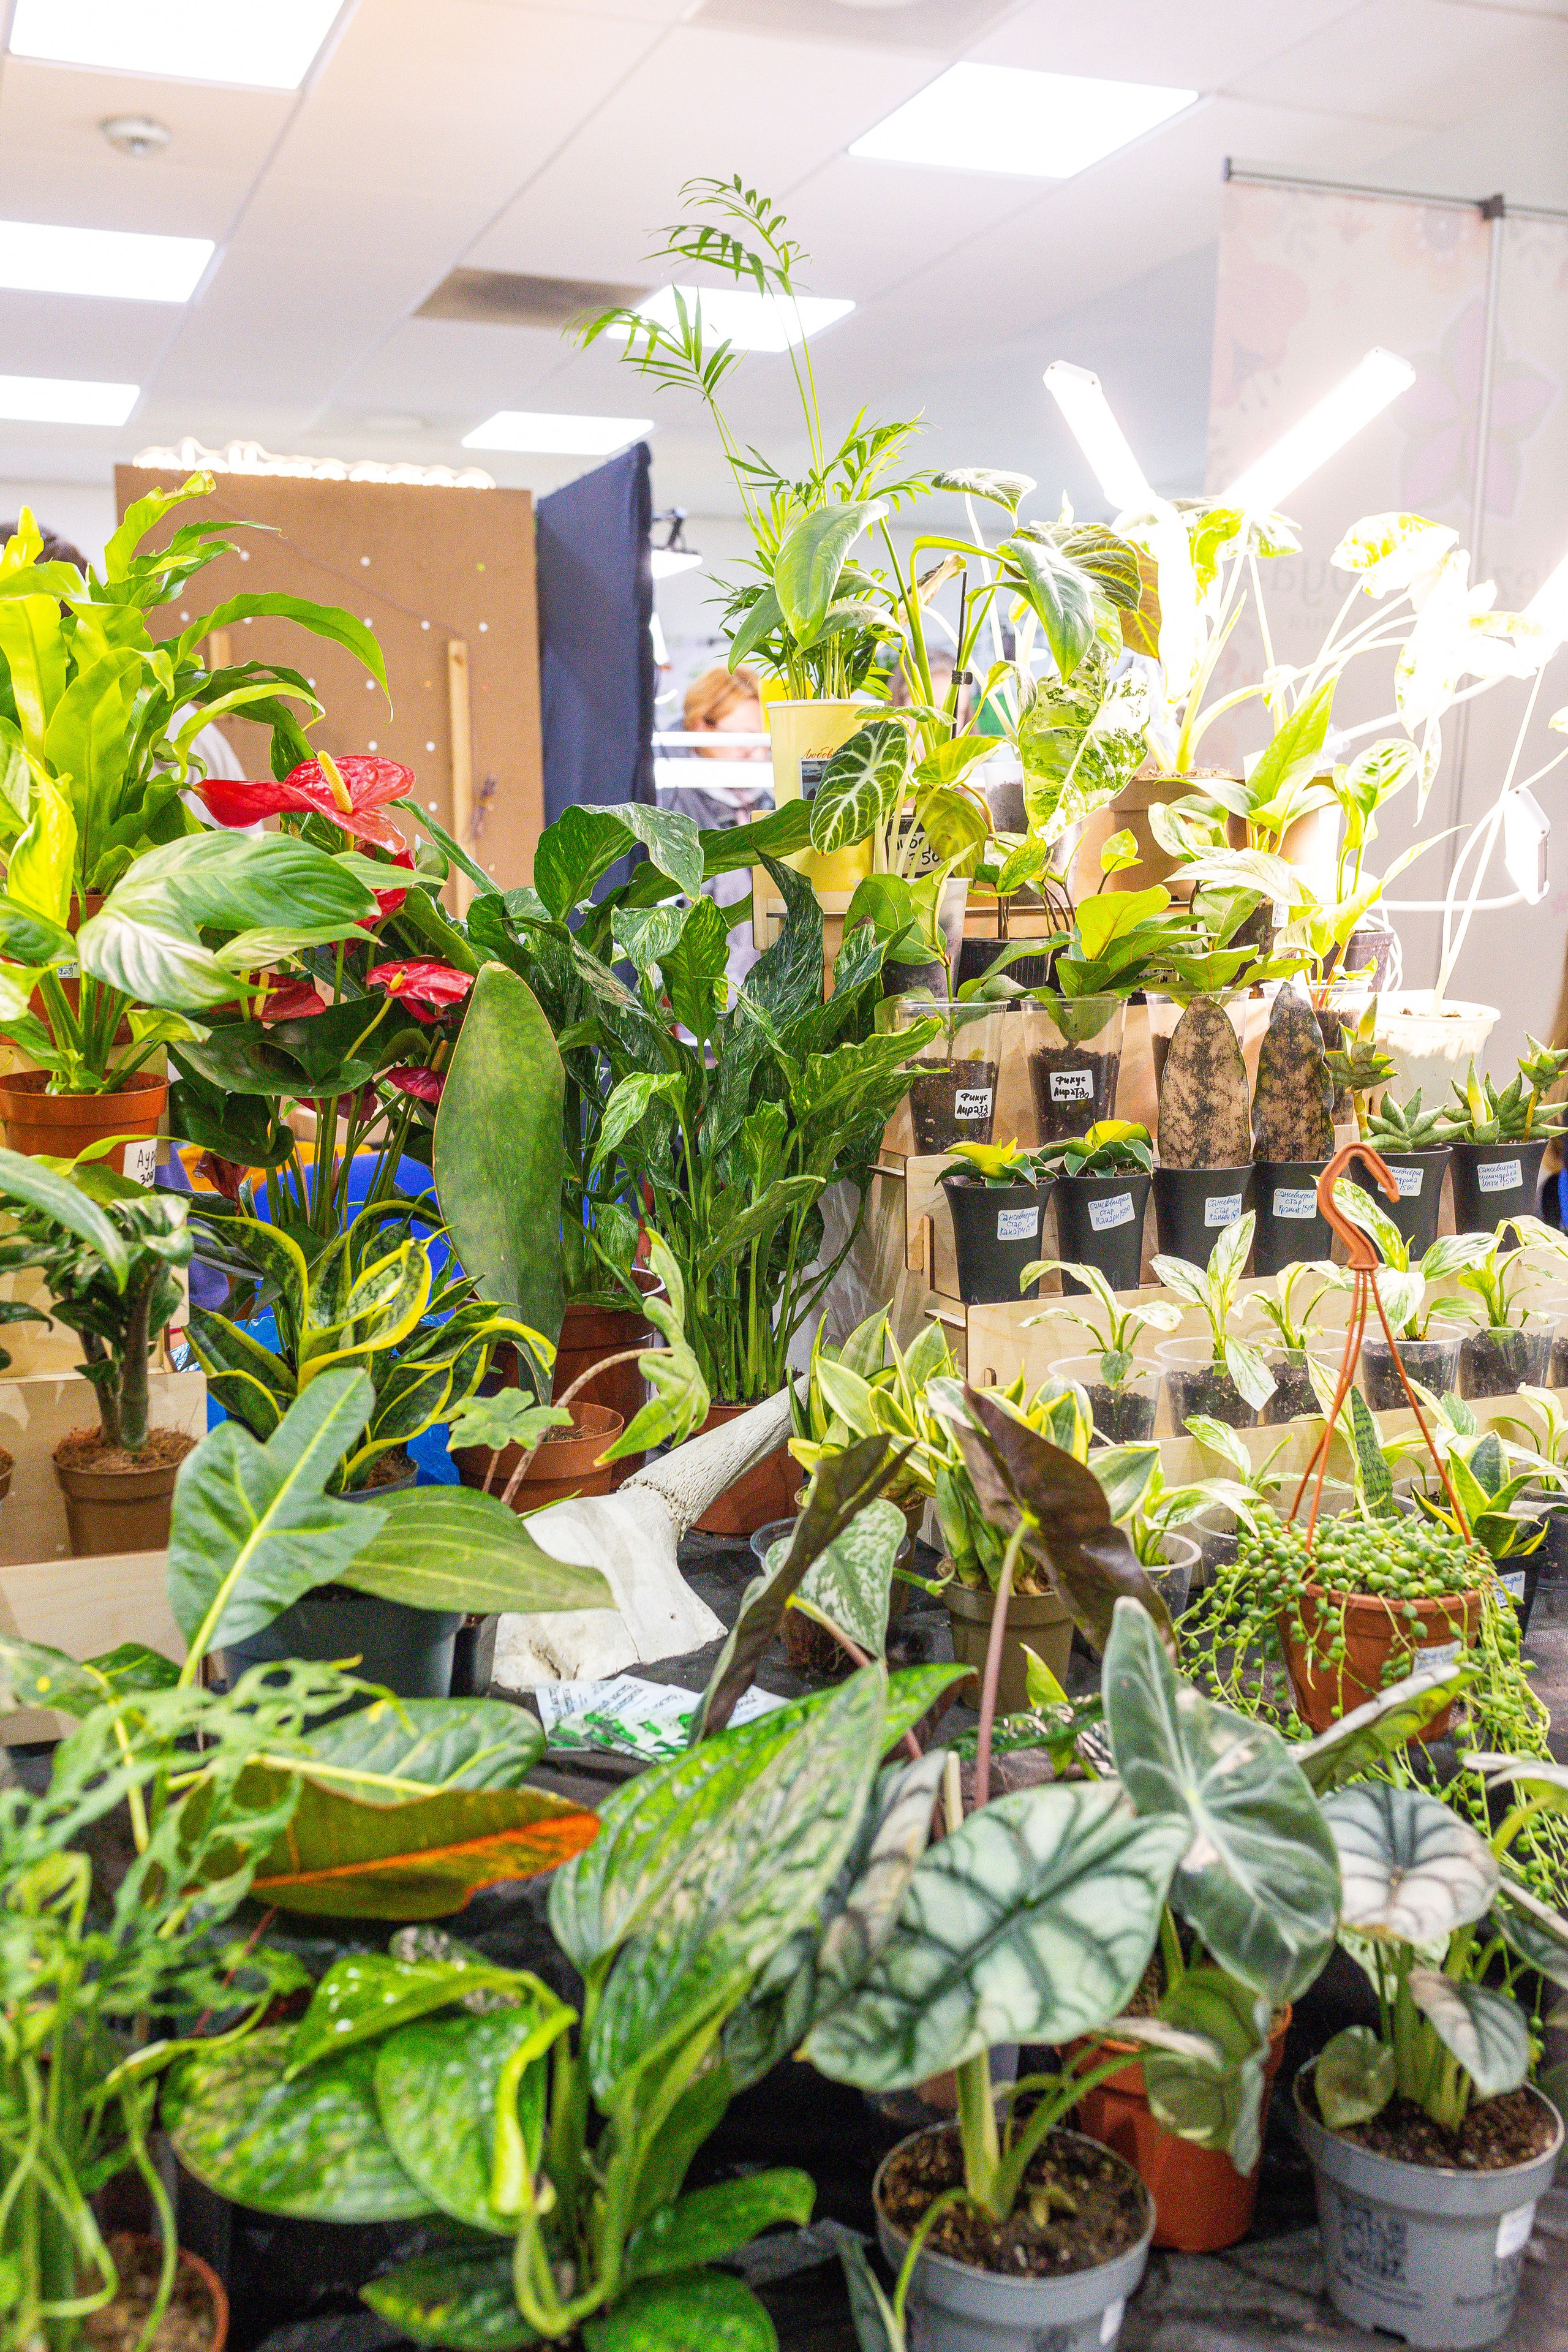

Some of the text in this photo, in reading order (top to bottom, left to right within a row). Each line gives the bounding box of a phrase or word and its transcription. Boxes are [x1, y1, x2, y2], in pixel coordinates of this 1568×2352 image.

[801, 746, 834, 760] Любов
[1055, 1076, 1086, 1087] Фикус
[960, 1093, 988, 1104] Фикус
[956, 1104, 988, 1117] Лирата
